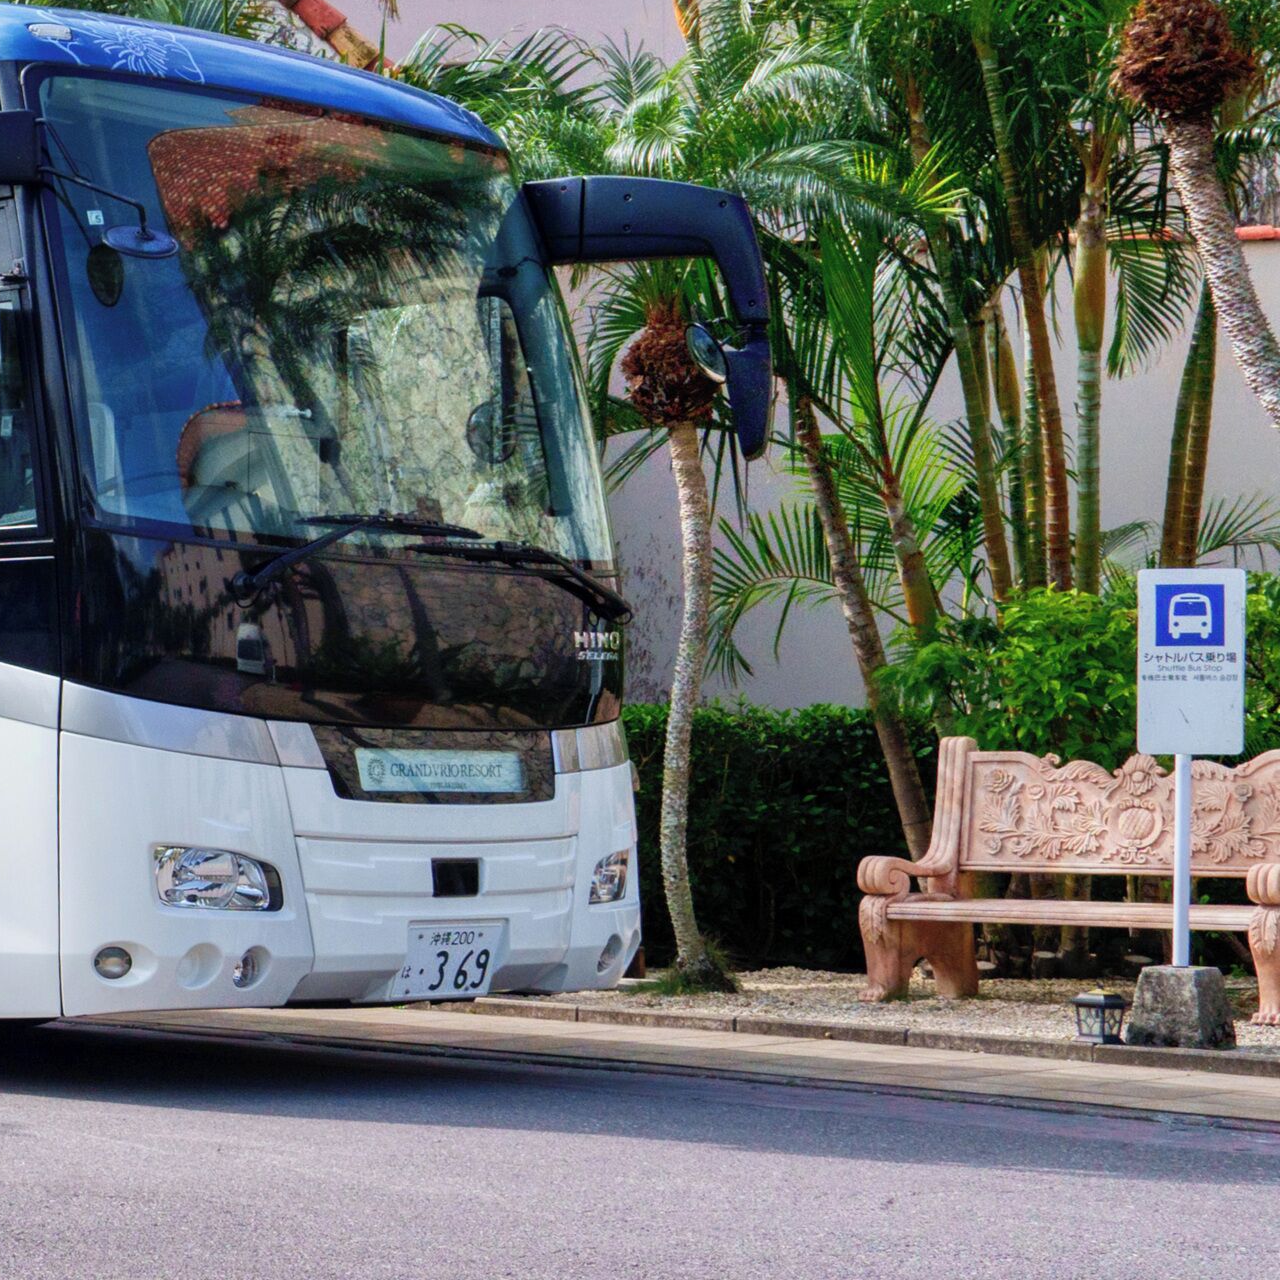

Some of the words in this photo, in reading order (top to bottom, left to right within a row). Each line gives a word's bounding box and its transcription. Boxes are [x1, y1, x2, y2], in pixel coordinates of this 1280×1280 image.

[574, 631, 620, 650] HINO
[1143, 651, 1237, 664] シャトルバス乗り場
[1203, 664, 1223, 673] Stop
